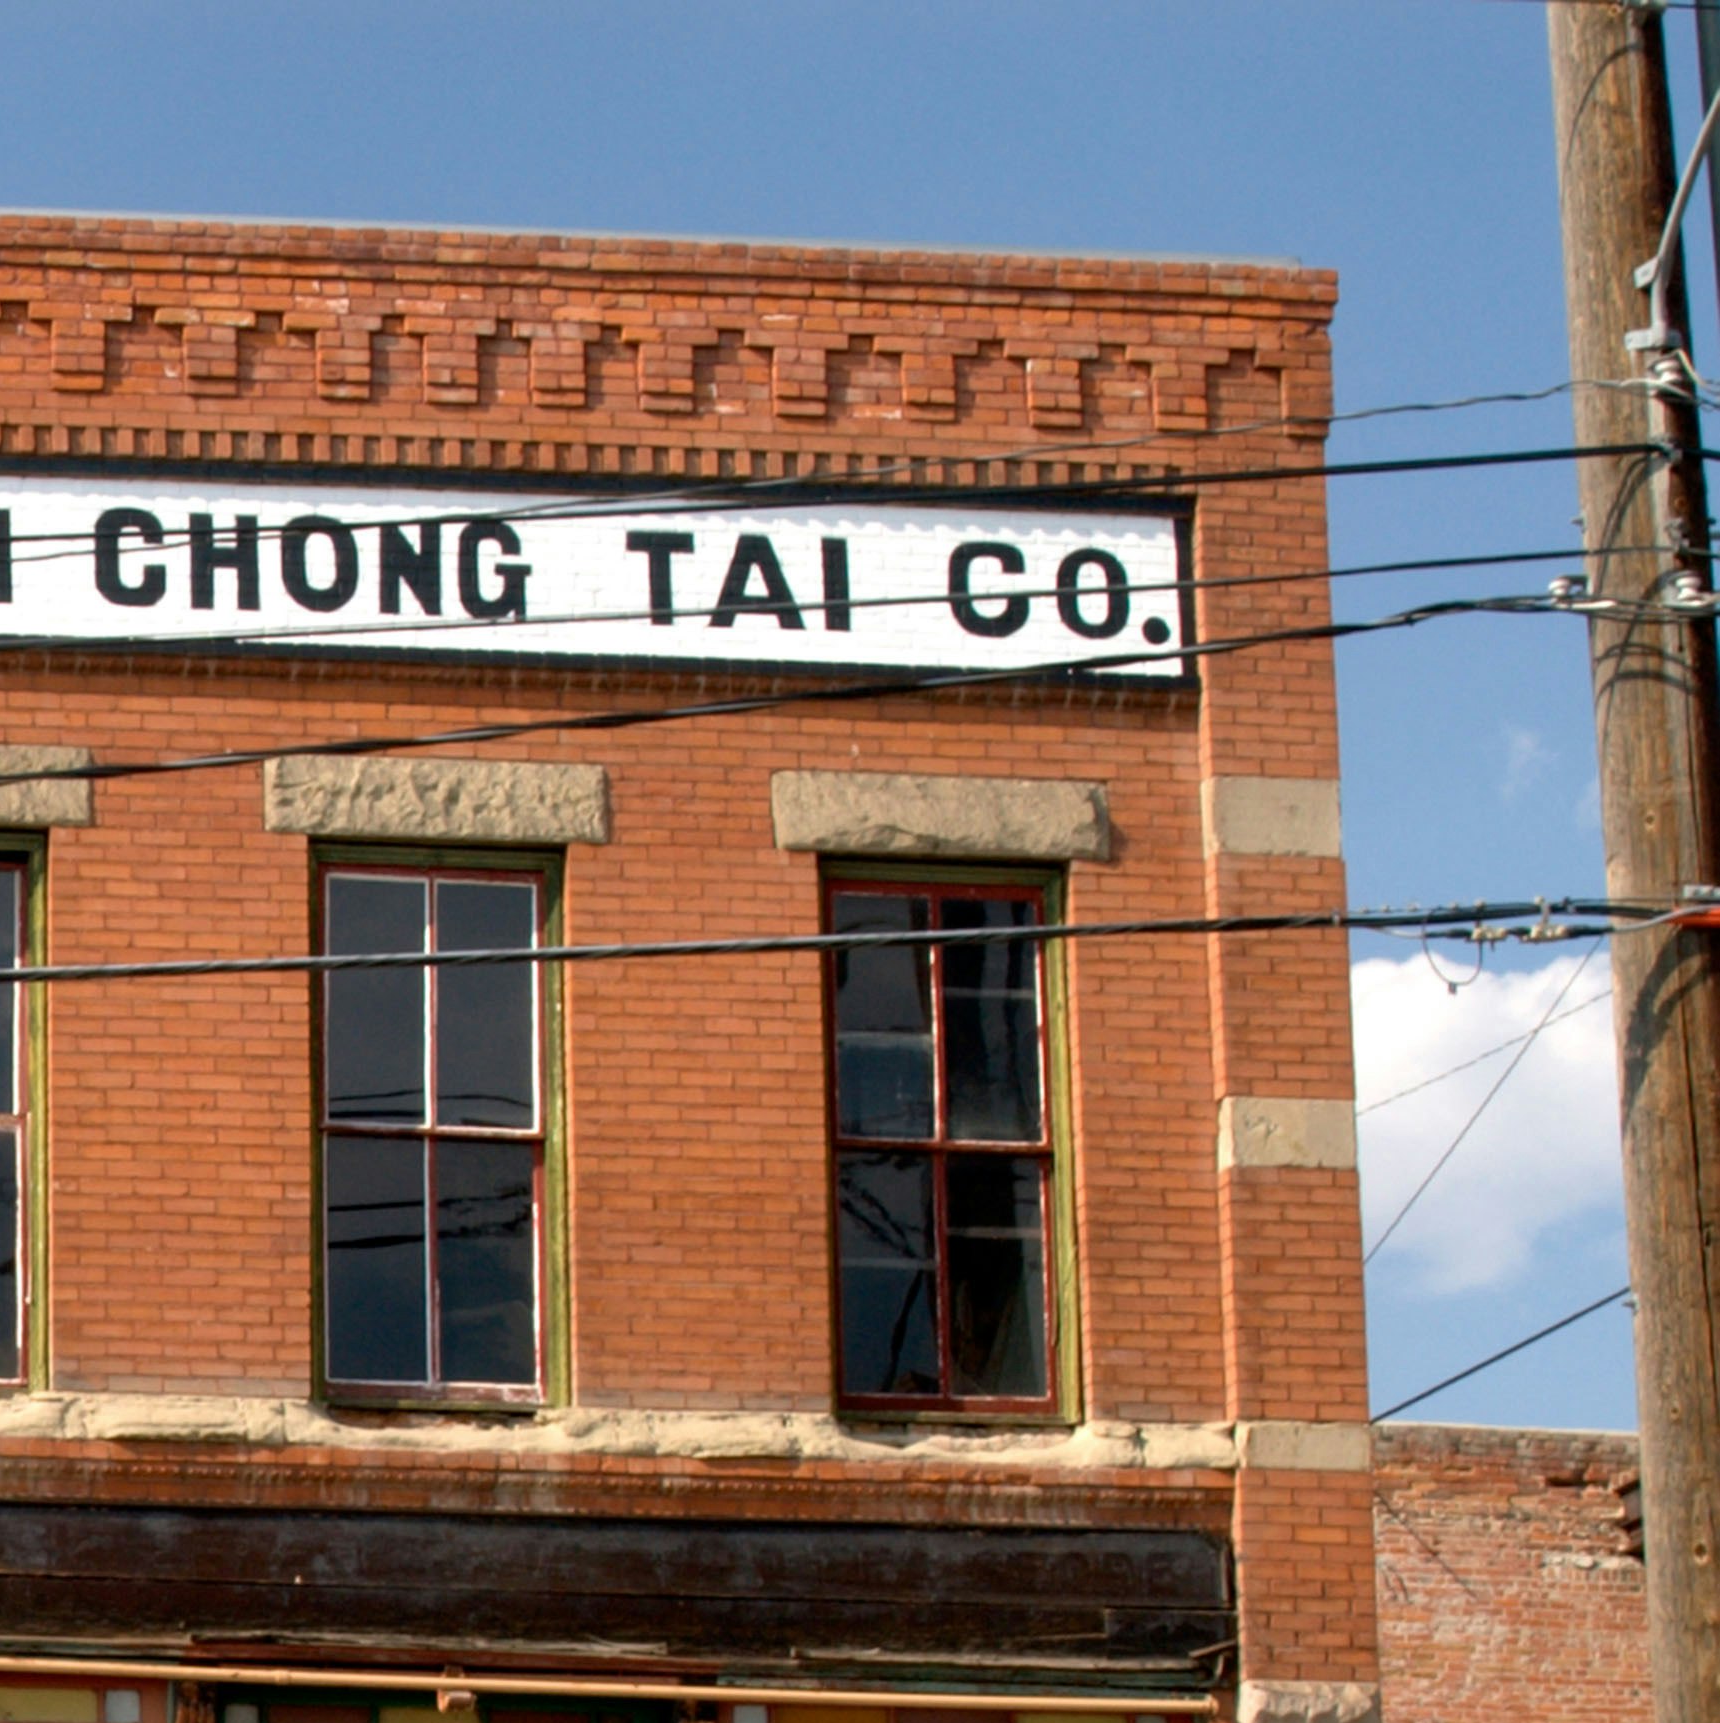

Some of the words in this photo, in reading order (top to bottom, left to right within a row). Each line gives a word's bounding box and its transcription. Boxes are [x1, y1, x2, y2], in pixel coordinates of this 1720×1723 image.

[94, 505, 528, 624] CHONG
[625, 530, 850, 634] TAI
[947, 540, 1174, 646] CO.
